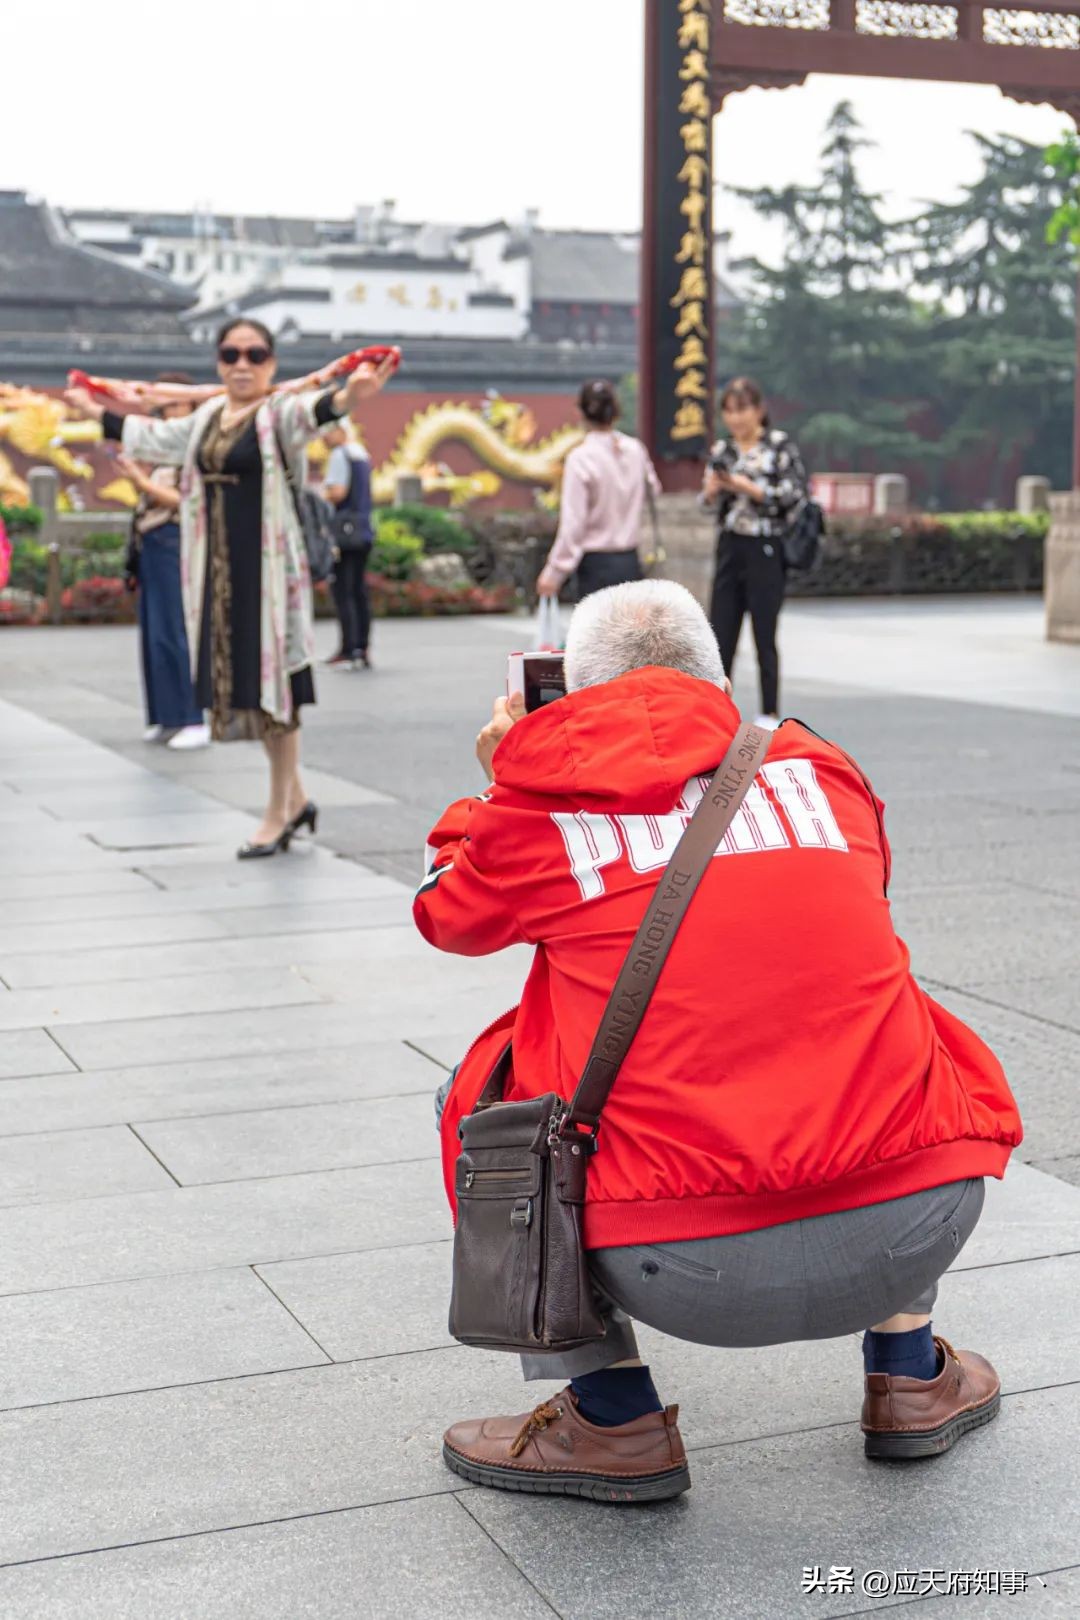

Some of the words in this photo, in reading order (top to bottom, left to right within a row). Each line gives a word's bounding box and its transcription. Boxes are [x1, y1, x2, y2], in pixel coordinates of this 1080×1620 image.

[711, 764, 747, 809] YING
[662, 869, 692, 900] DA
[631, 908, 674, 976] HONG
